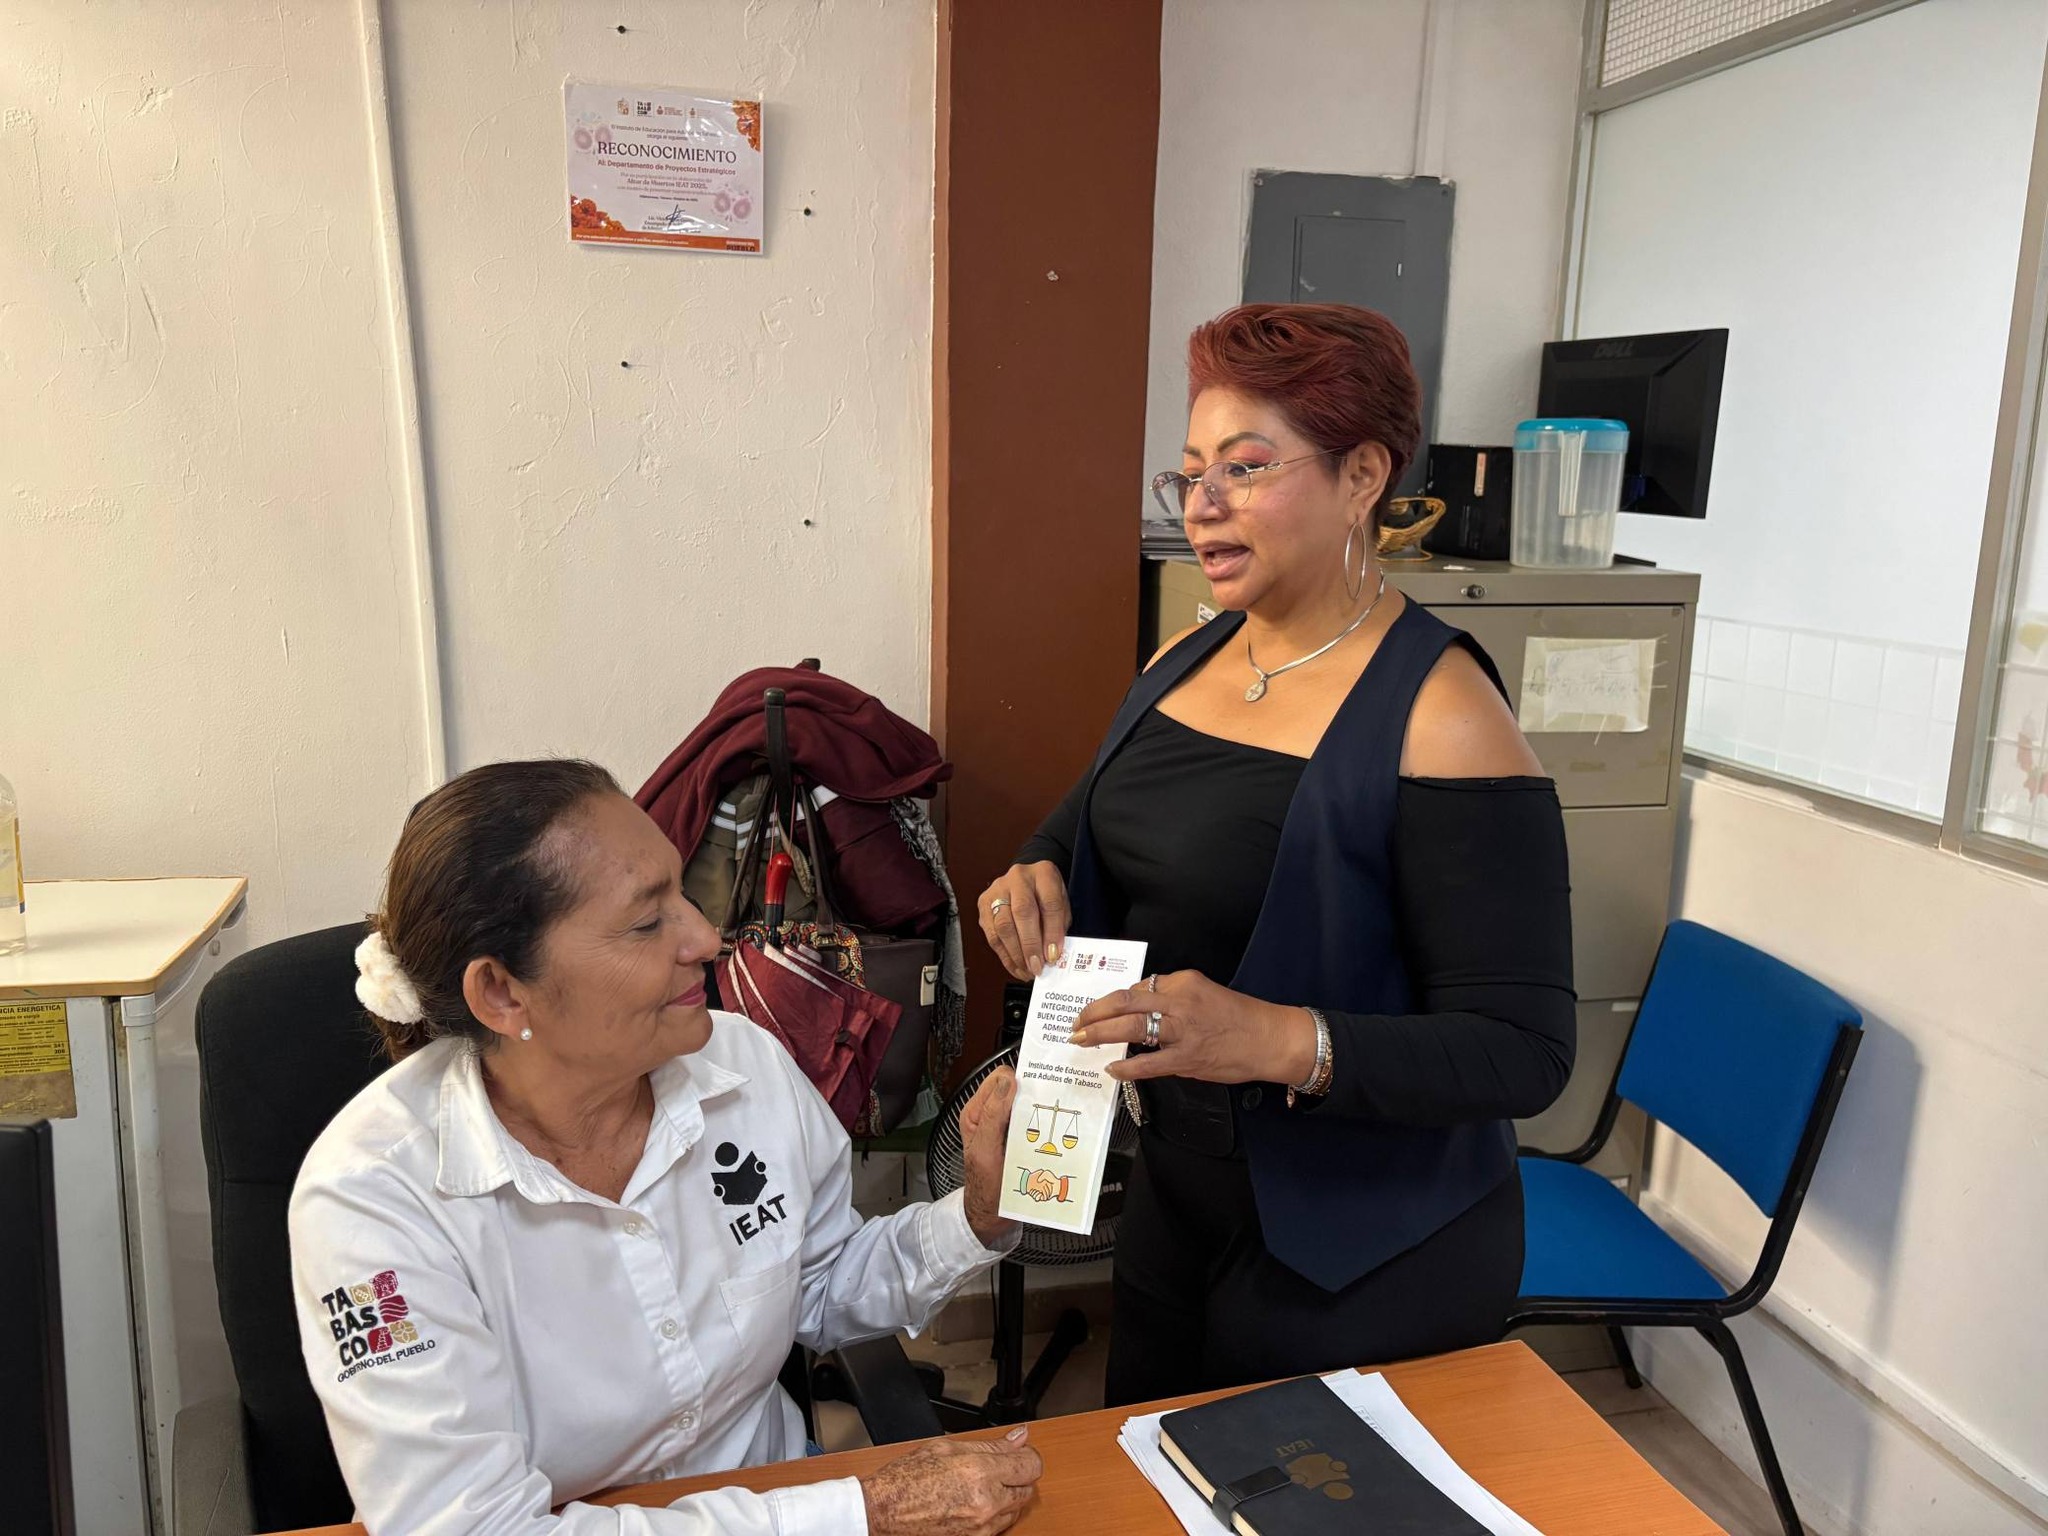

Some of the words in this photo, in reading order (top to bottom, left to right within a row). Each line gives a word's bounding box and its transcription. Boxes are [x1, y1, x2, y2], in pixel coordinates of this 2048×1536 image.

[597, 141, 737, 163] RECONOCIMIENTO
[607, 160, 654, 169] Departamento
[665, 164, 697, 173] Proyectos
[697, 166, 736, 175] Estratégicos
[1044, 990, 1074, 1003] CÓDIGO
[1074, 995, 1085, 1004] DE
[1036, 1011, 1056, 1021] BUEN
[1041, 1001, 1083, 1014] INTEGRIDAD
[1023, 1071, 1037, 1079] para
[1037, 1071, 1063, 1083] Adultos
[1063, 1076, 1073, 1084] de
[1074, 1077, 1103, 1089] Tabasco
[1028, 1061, 1054, 1071] Instituto
[1054, 1064, 1064, 1073] de
[1064, 1066, 1099, 1079] Educación
[729, 1193, 787, 1246] IEAT
[321, 1286, 354, 1317] TA
[329, 1305, 379, 1342] BAS
[339, 1335, 369, 1367] CO
[375, 1354, 396, 1367] DEL
[396, 1339, 436, 1361] PUEBLO
[1276, 1438, 1316, 1458] IEAT
